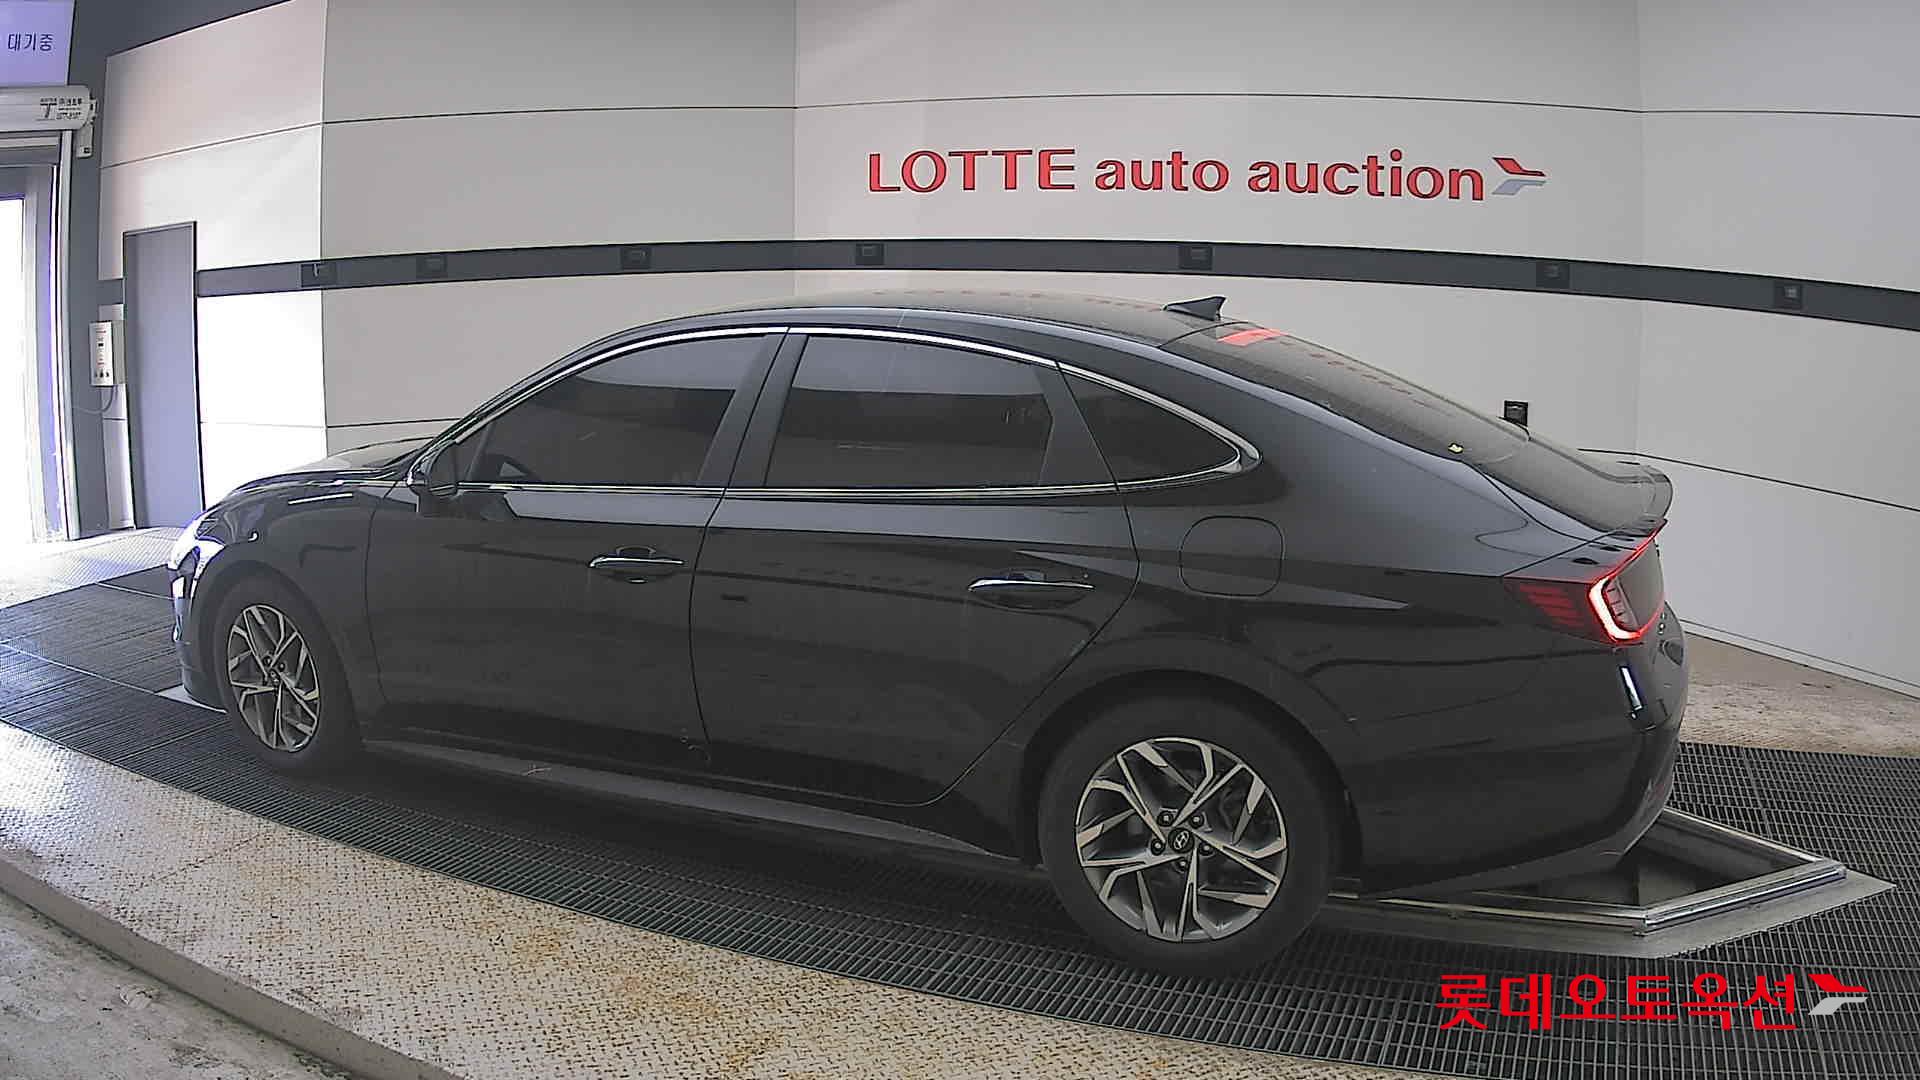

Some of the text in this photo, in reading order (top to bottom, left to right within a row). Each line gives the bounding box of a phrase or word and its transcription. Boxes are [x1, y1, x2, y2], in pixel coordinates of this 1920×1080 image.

[7, 33, 53, 52] 대기중
[869, 149, 1484, 199] LOTTE auto auction
